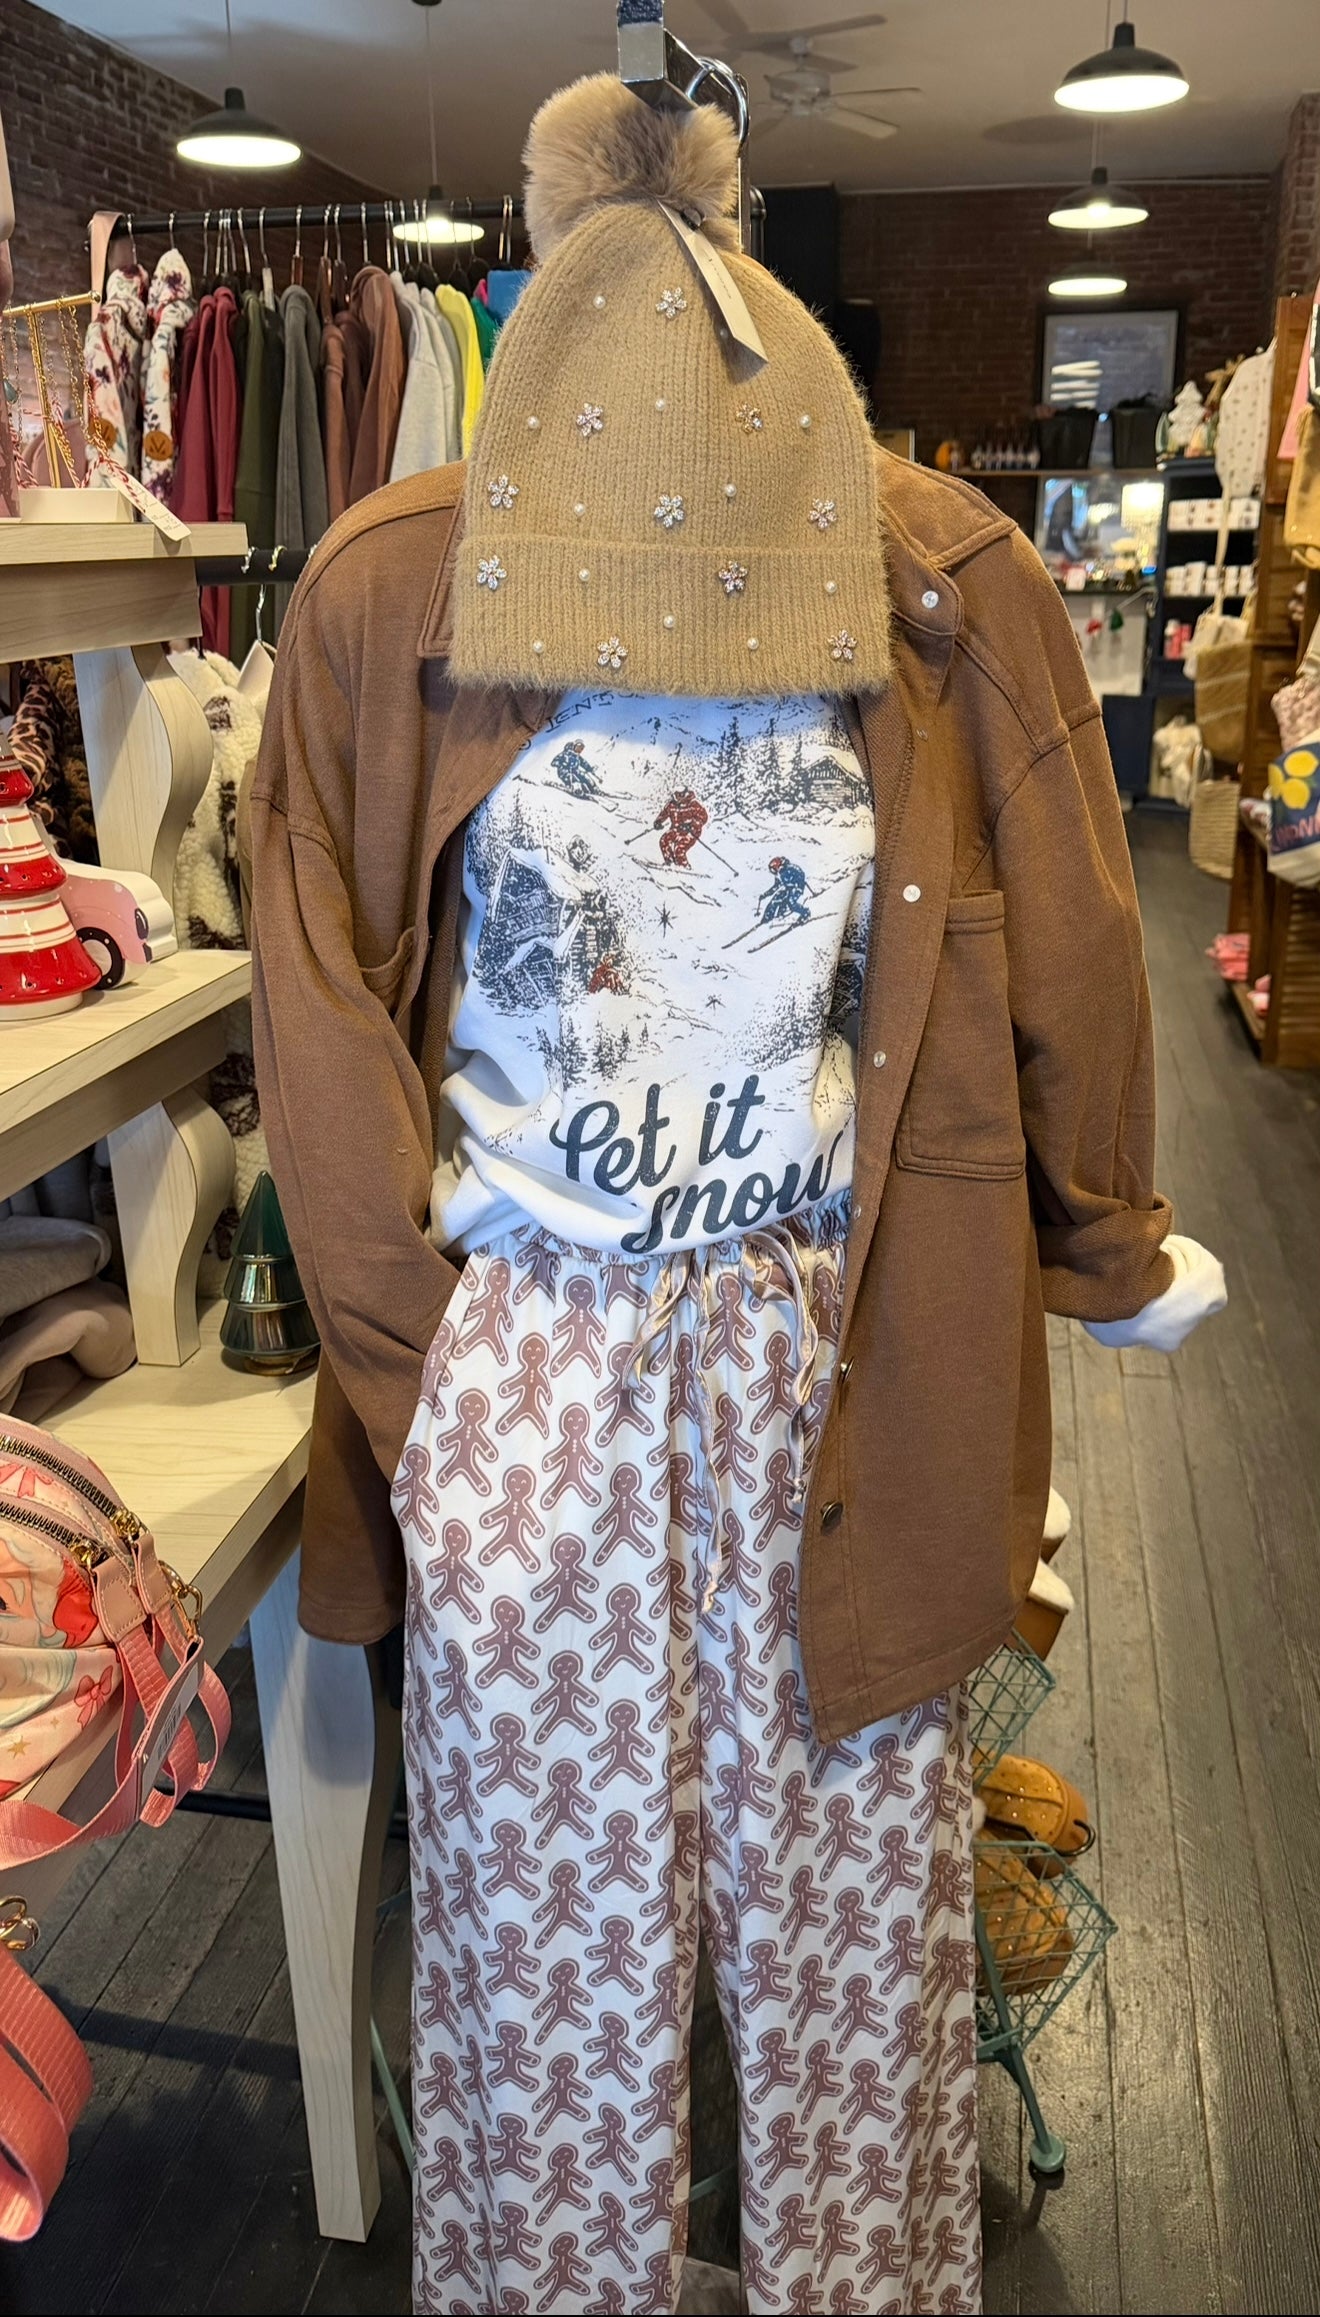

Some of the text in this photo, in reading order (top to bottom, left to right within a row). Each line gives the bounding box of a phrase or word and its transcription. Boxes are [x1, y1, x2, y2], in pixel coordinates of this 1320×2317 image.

[549, 1074, 766, 1196] Let it
[620, 1130, 844, 1254] snow
